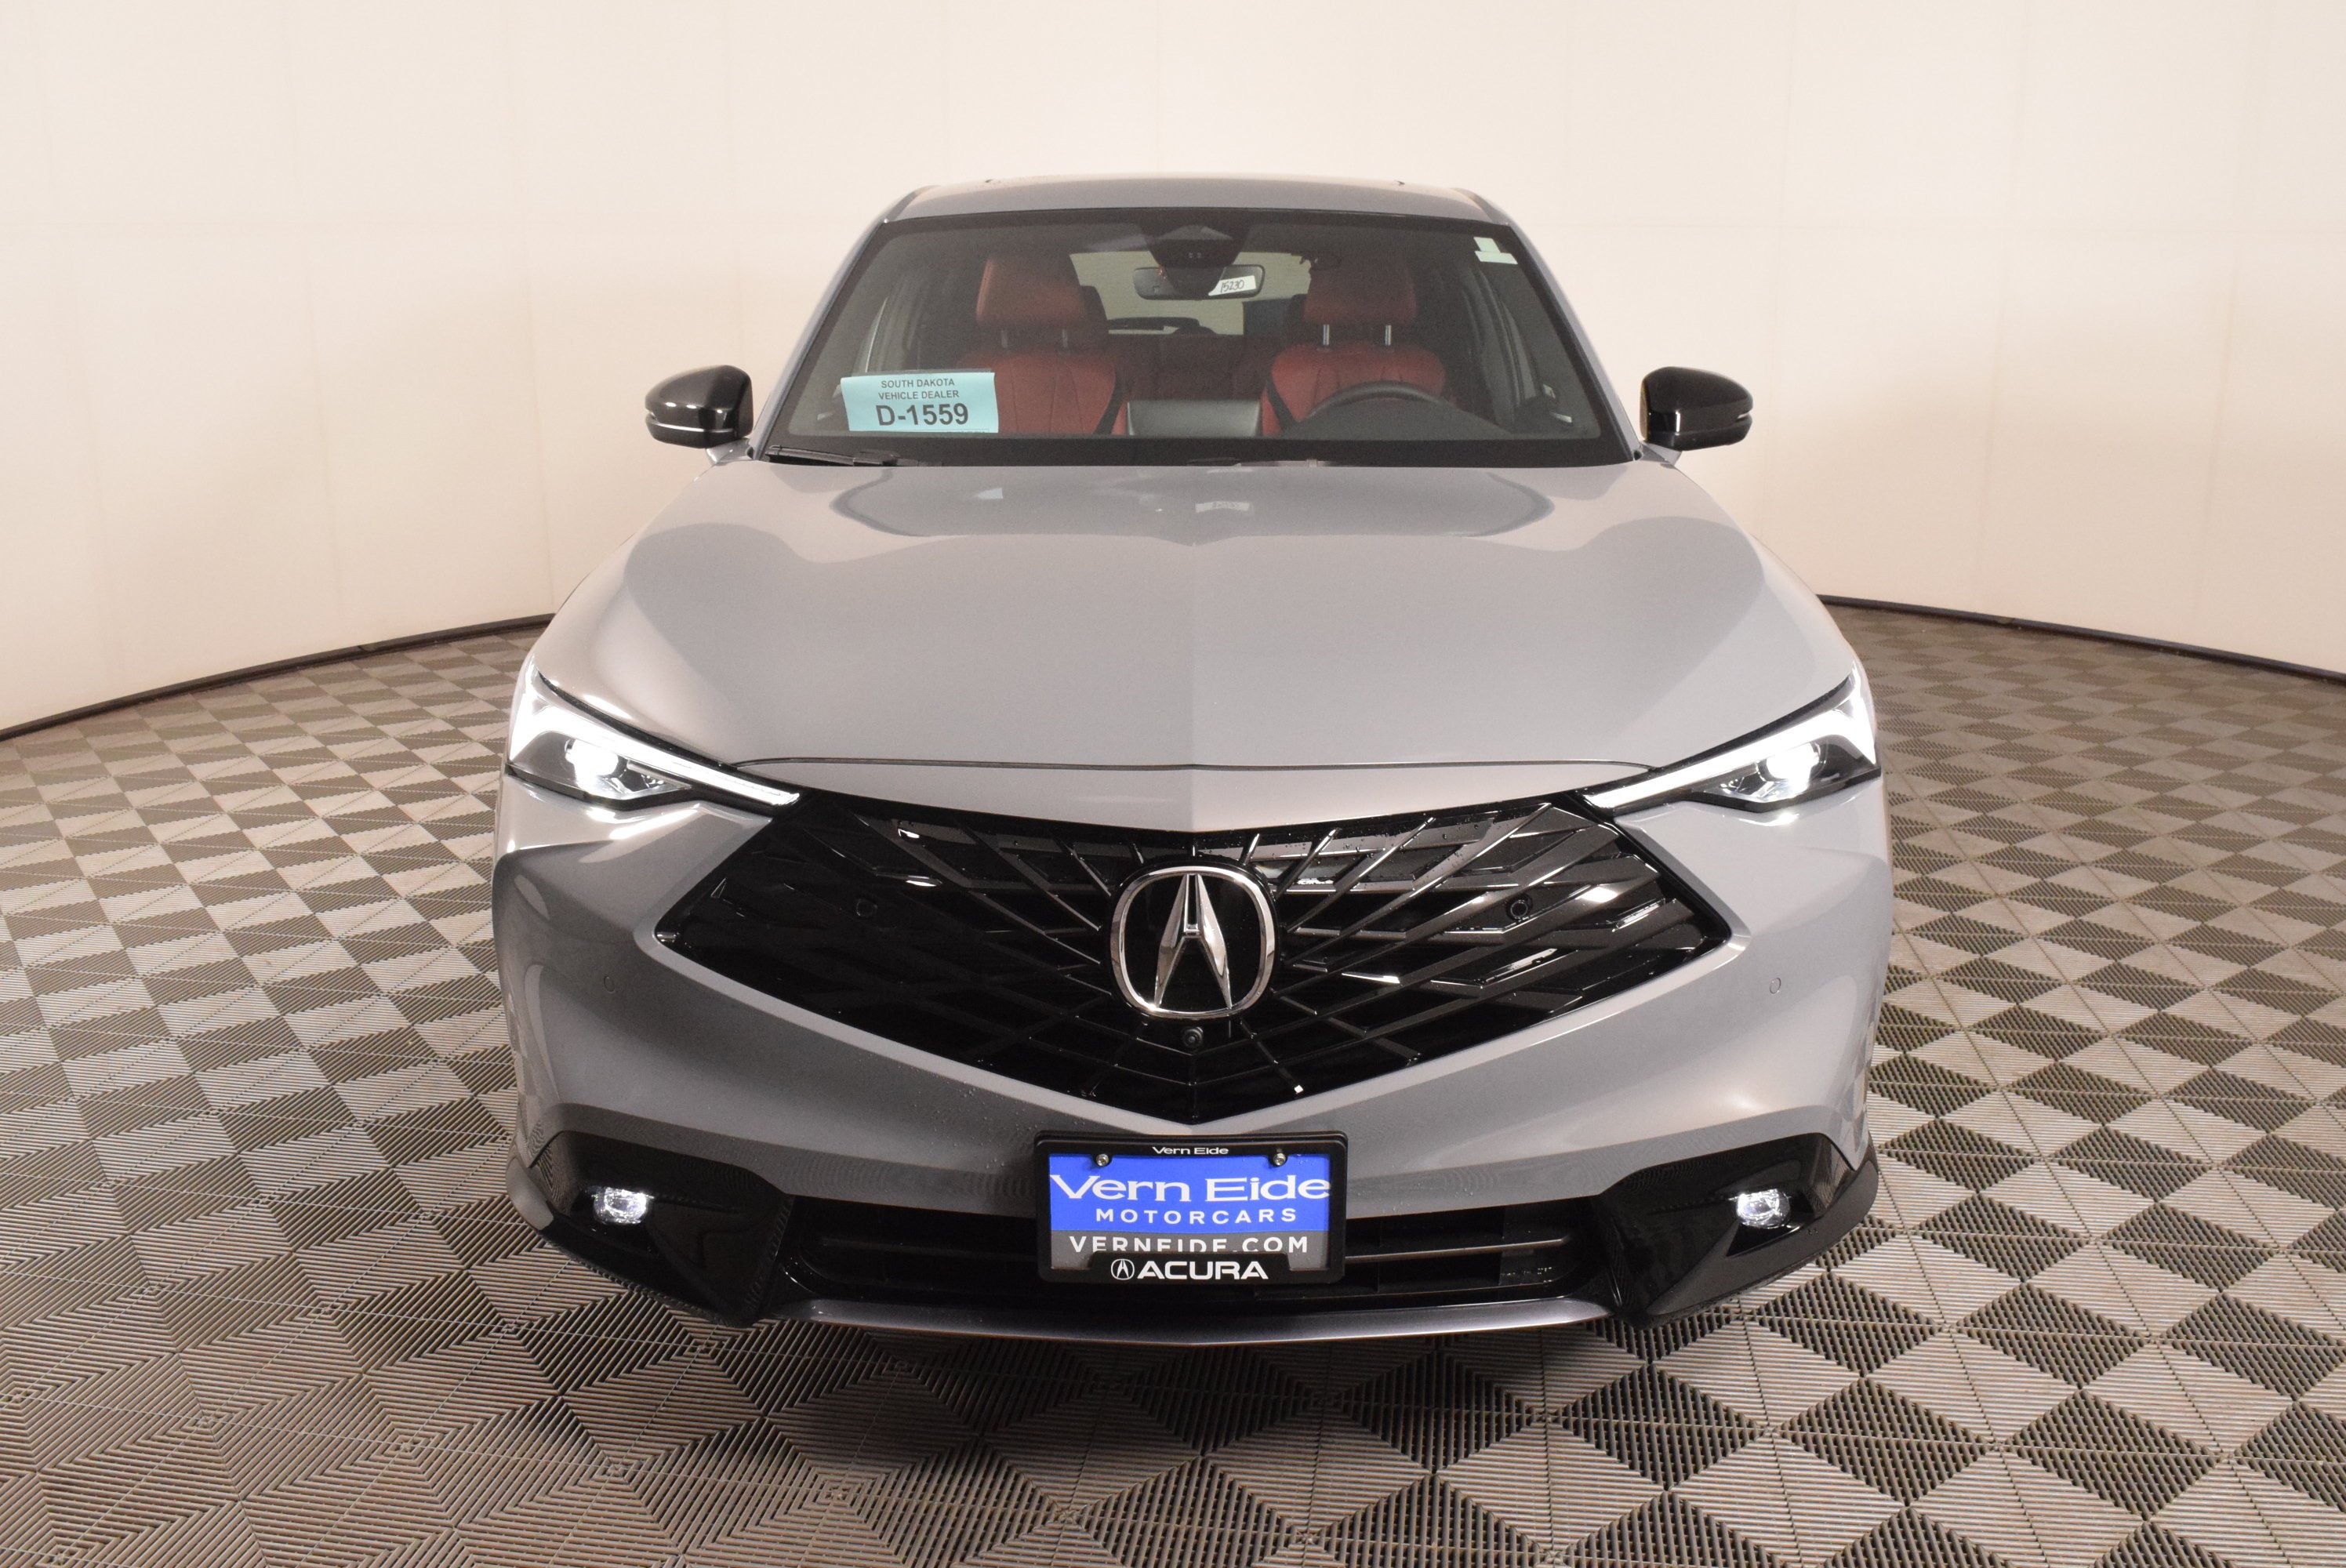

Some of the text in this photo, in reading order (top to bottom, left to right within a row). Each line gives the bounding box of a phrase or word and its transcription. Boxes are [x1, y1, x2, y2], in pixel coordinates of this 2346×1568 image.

[881, 378, 955, 389] SOUTH DAKOTA
[878, 390, 959, 400] VEHICLE DEALER
[876, 403, 968, 426] D-1559
[1152, 1146, 1229, 1156] Vern Eide
[1050, 1174, 1331, 1202] Vern Eide
[1096, 1208, 1296, 1225] MOTORCARS
[1137, 1261, 1269, 1279] ACURA
